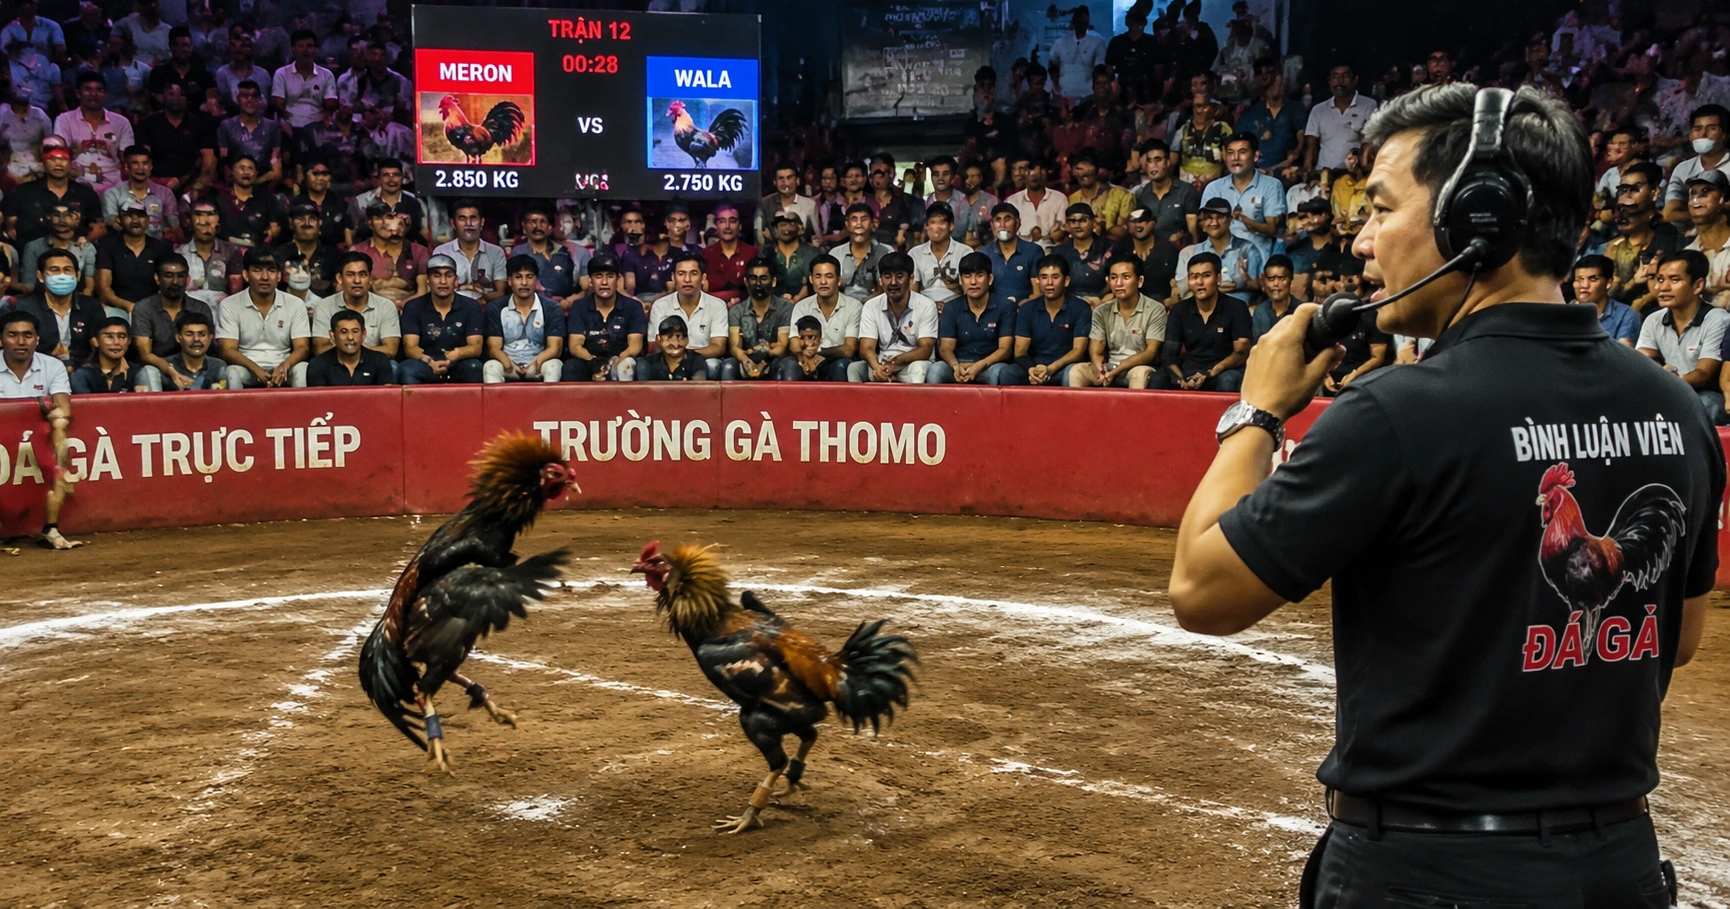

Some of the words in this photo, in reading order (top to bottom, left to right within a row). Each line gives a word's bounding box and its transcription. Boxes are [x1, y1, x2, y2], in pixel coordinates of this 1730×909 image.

[548, 16, 602, 44] TRẬN
[609, 21, 631, 40] 12
[439, 62, 513, 83] MERON
[562, 54, 619, 74] 00:28
[674, 69, 732, 89] WALA
[577, 117, 604, 134] VS
[435, 170, 487, 188] 2.850
[493, 171, 519, 189] KG
[663, 174, 714, 191] 2.750
[718, 174, 743, 192] KG
[533, 409, 711, 462] TRƯỜNG
[724, 411, 783, 462] GÀ
[792, 420, 947, 466] THOMO
[1511, 416, 1571, 463] BÌNH
[1572, 415, 1631, 466] LUẬN
[1634, 413, 1686, 456] VIÊN
[63, 426, 123, 483] GÀ
[132, 426, 255, 483] TRỰC
[1522, 610, 1586, 672] ĐÁ
